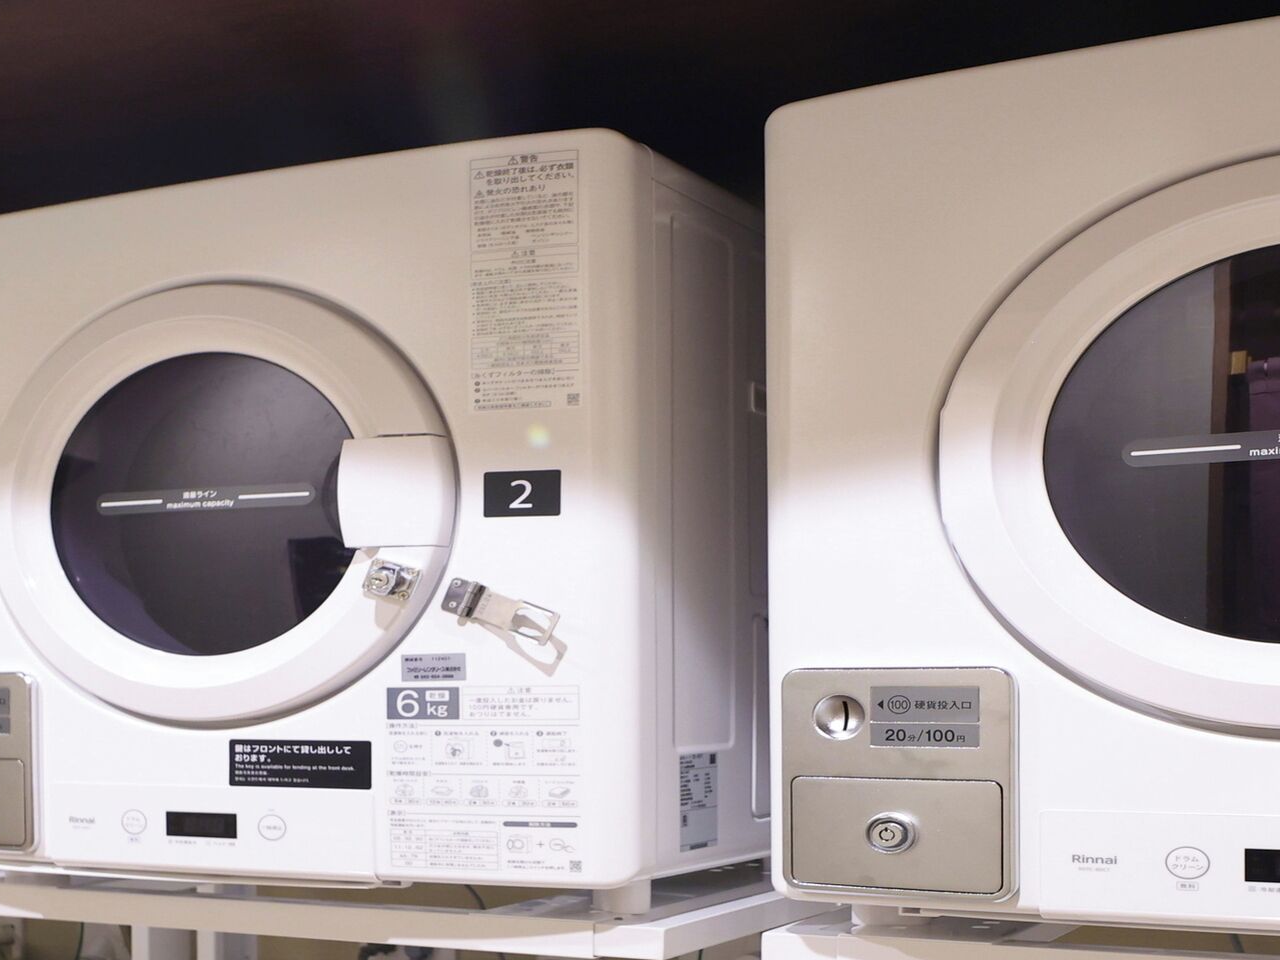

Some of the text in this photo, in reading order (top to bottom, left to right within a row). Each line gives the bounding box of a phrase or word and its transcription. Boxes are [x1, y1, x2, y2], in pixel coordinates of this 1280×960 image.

[509, 479, 533, 508] 2
[166, 499, 234, 509] maximum capacity
[396, 690, 448, 717] 6 kg
[891, 700, 972, 710] 100 硬貨投入口
[885, 729, 965, 742] 20分/100円
[235, 744, 351, 754] 鍵はフロントにて貸し出しして
[235, 754, 271, 762] おります。
[1072, 854, 1117, 865] Rinnai
